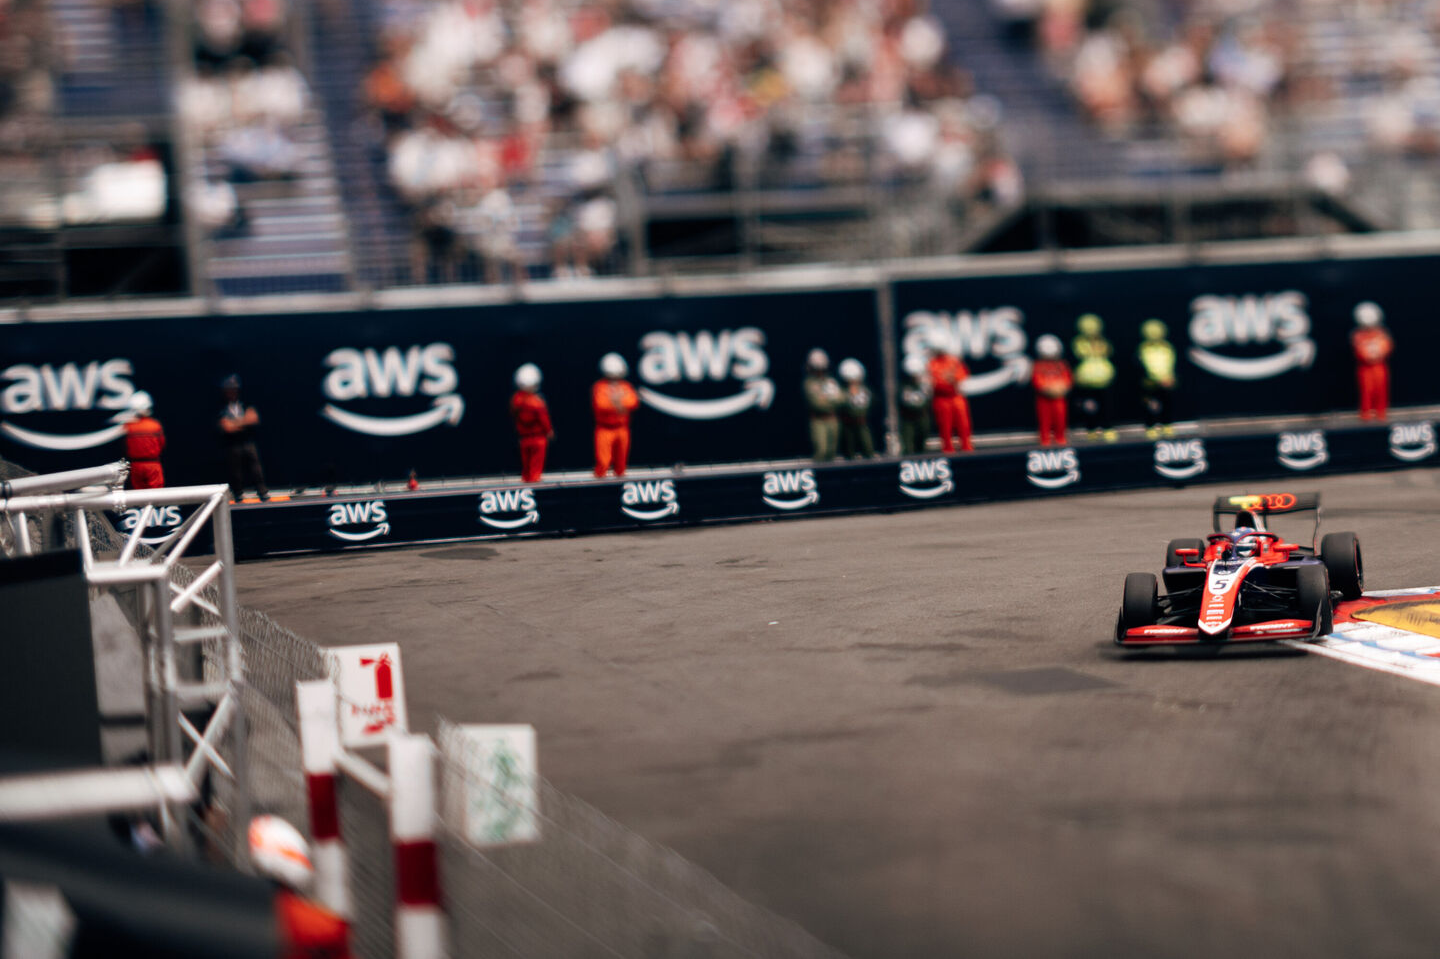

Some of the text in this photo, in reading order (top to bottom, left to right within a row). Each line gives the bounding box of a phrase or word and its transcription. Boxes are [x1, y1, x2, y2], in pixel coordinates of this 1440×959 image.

[1187, 291, 1311, 346] aws
[638, 327, 770, 385] aws
[322, 342, 459, 400] aws
[1, 359, 136, 414] aws
[1277, 429, 1327, 454] aws
[1389, 421, 1436, 445] aws
[1027, 448, 1078, 473] aws
[1154, 438, 1204, 463] aws
[763, 469, 816, 494] aws
[900, 457, 951, 483] aws
[480, 488, 536, 514] aws
[622, 480, 676, 504] aws
[124, 505, 182, 529] aws
[329, 500, 388, 526] aws
[1212, 579, 1230, 590] 5
